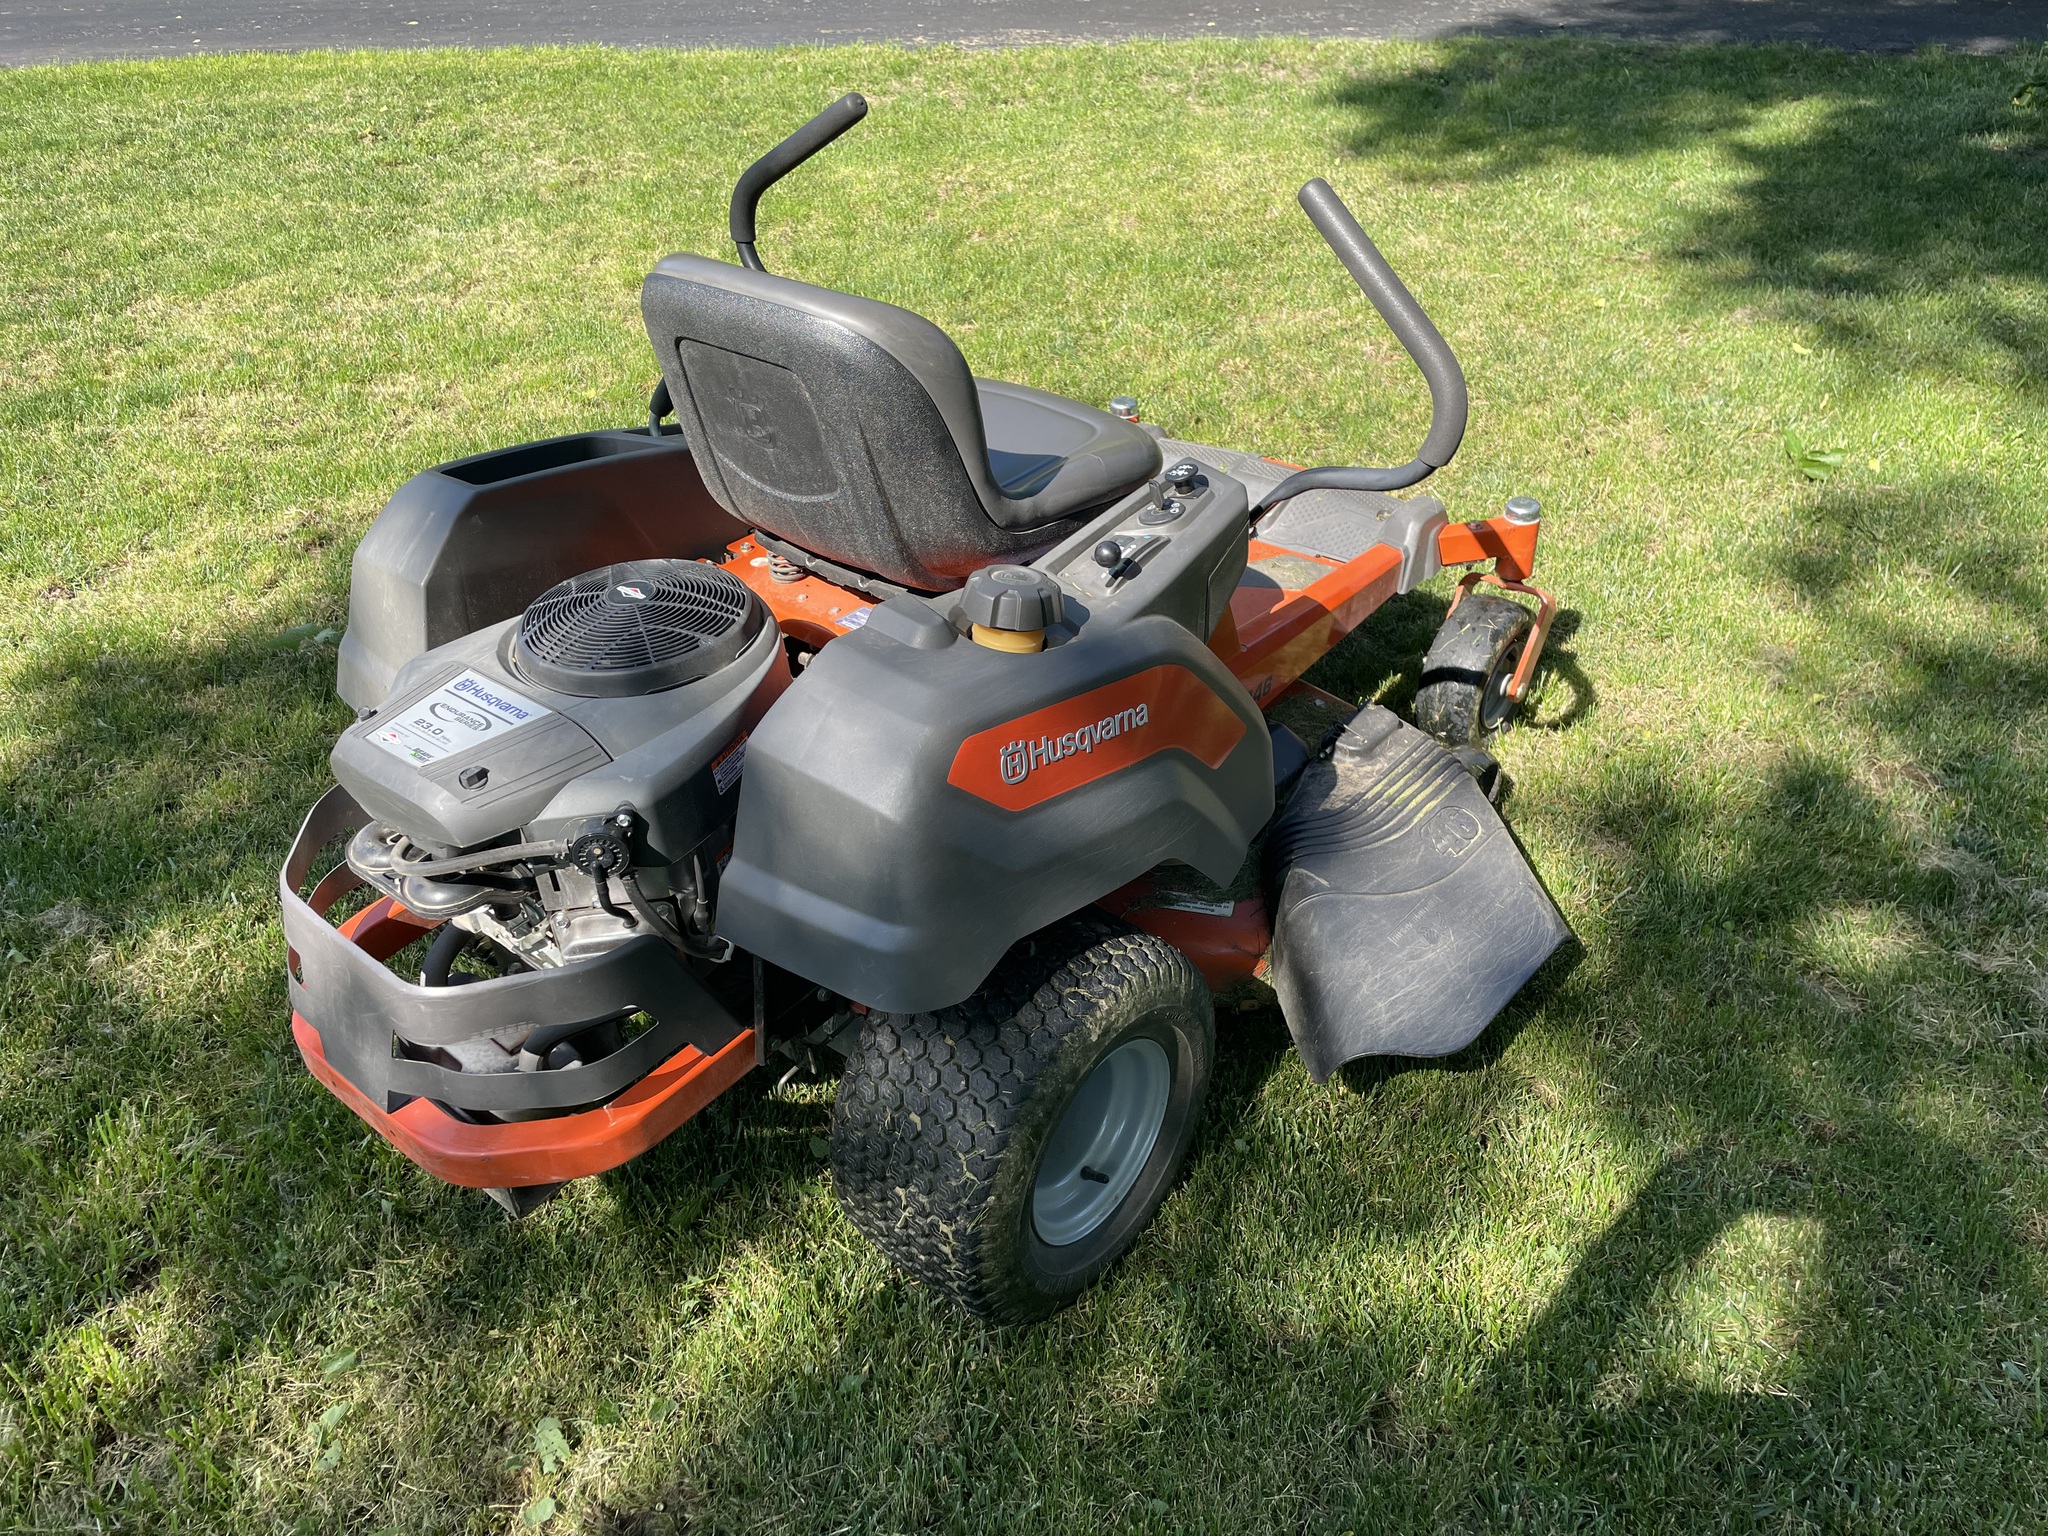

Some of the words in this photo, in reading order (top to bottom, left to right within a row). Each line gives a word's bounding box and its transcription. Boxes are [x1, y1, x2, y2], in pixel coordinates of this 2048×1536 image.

[440, 703, 485, 727] ENDURANCE
[467, 684, 529, 720] Husqvarna
[413, 718, 444, 736] 23.0
[454, 716, 481, 731] SERIES
[1029, 703, 1149, 771] Husqvarna
[1425, 808, 1481, 857] 46
